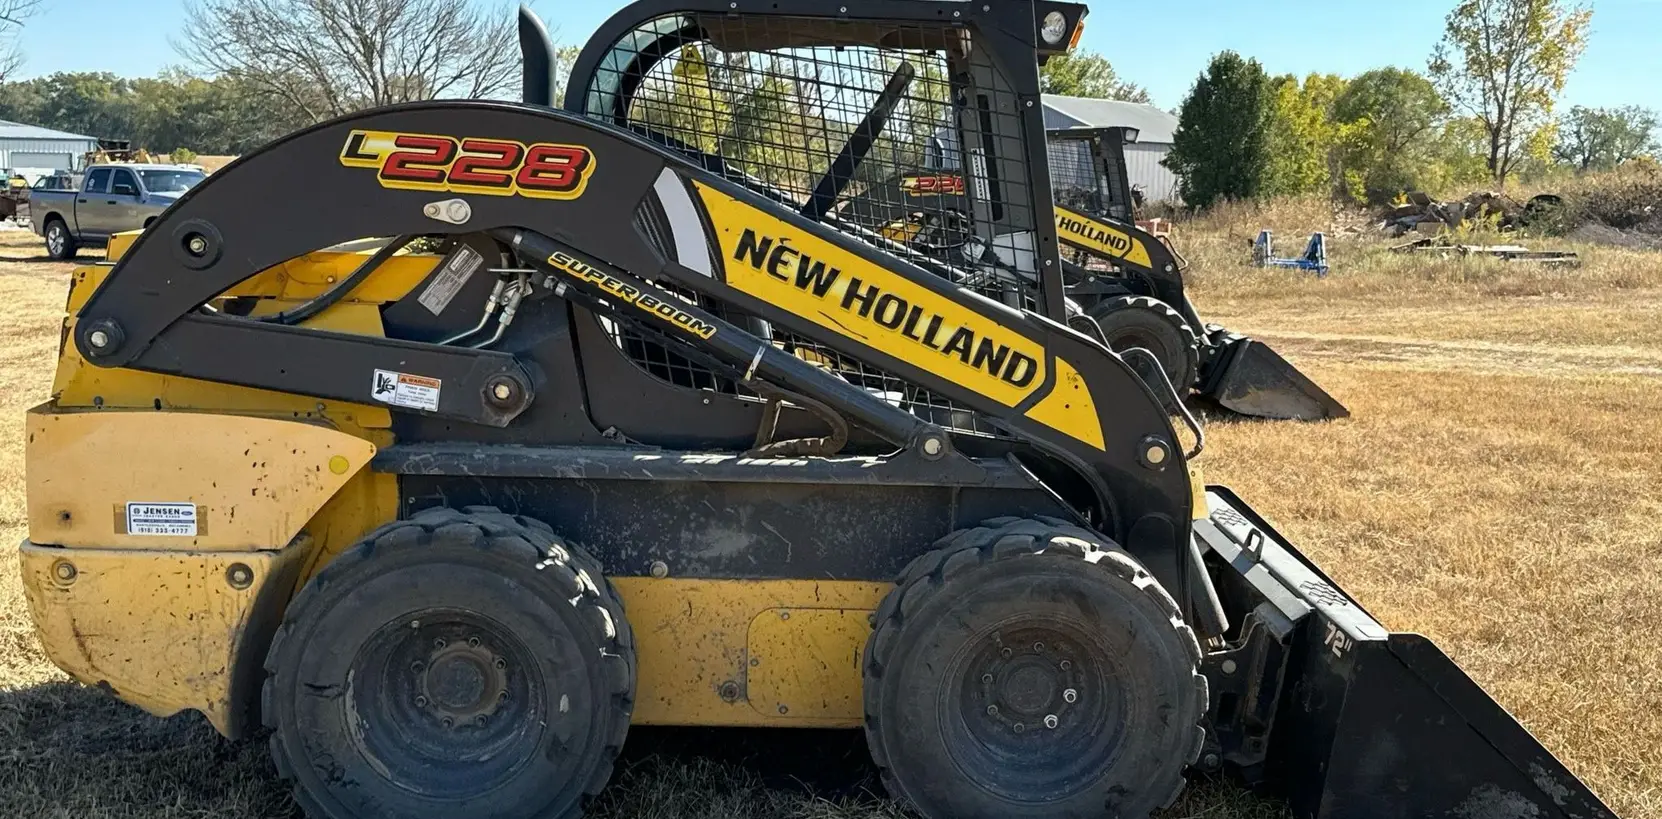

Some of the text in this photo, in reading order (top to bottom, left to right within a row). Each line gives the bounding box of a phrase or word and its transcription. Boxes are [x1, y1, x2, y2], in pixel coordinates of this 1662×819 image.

[340, 130, 595, 199] L228
[1058, 216, 1127, 251] HOLLAND
[548, 252, 717, 340] SUPER BOOM
[733, 228, 1039, 389] NEW HOLLAND
[143, 507, 180, 515] JENSEN
